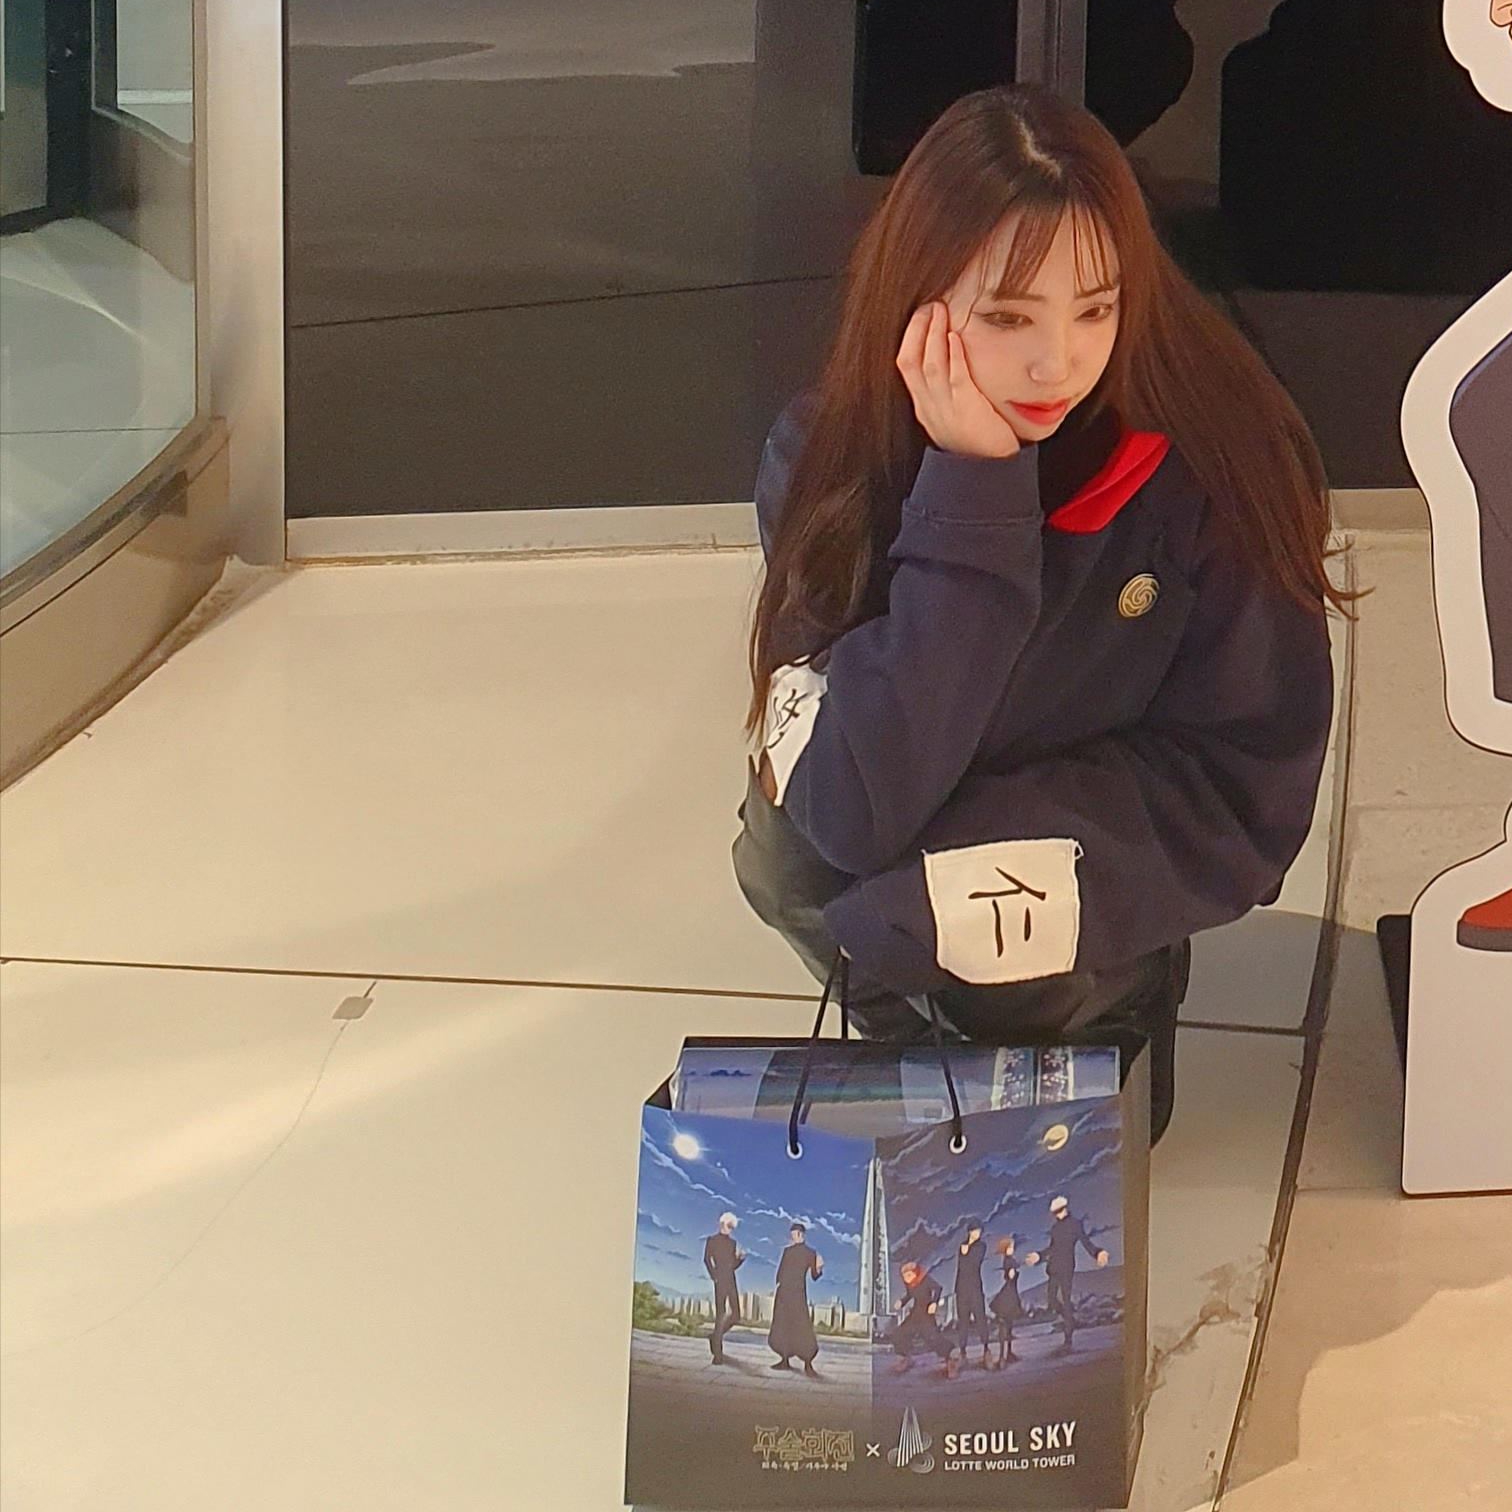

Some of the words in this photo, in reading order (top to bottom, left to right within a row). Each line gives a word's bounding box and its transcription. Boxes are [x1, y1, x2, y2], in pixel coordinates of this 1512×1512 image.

[752, 1424, 855, 1463] 주술회전
[943, 1430, 1019, 1456] SEOUL
[1029, 1420, 1077, 1452] SKY
[944, 1459, 982, 1471] LOTTE
[984, 1457, 1030, 1471] WORLD
[1032, 1453, 1076, 1469] TOWER
